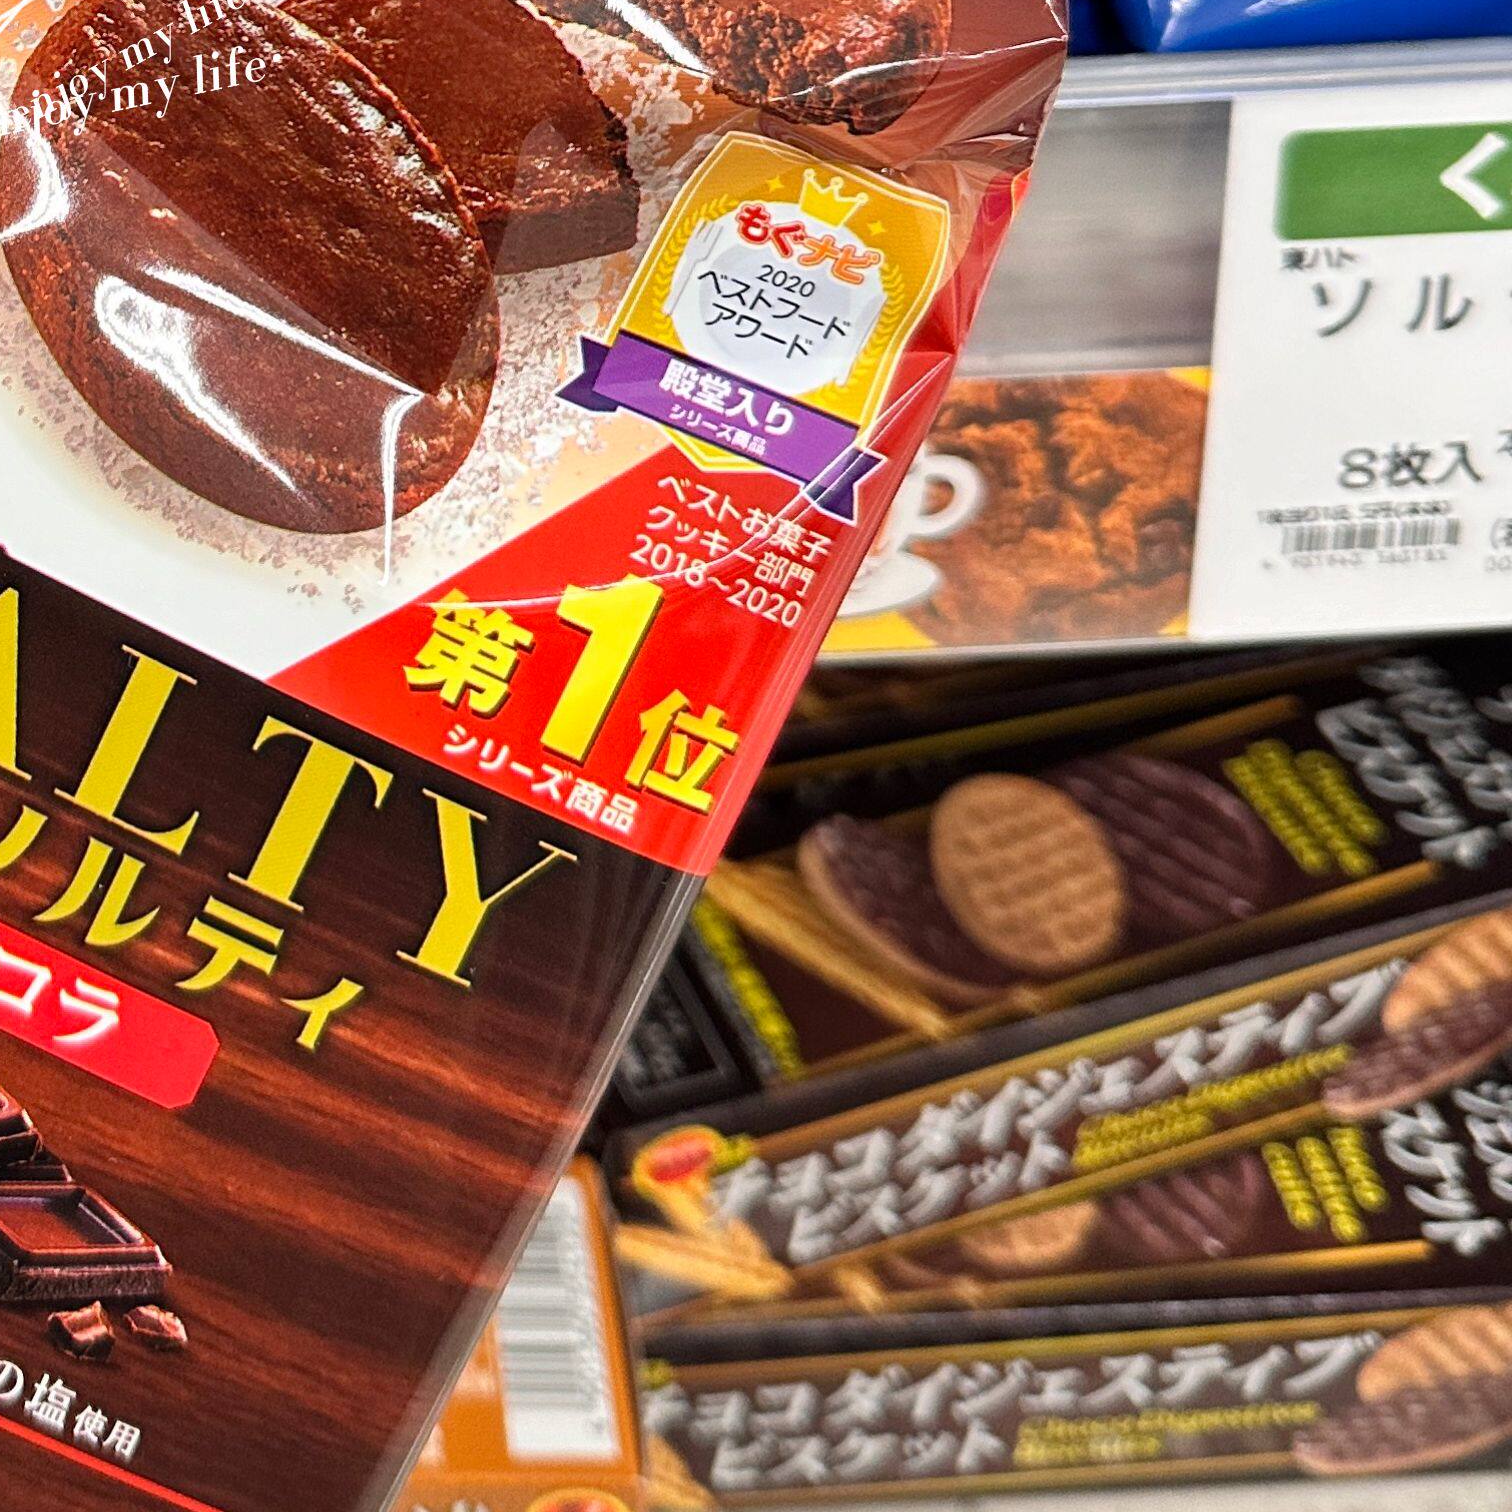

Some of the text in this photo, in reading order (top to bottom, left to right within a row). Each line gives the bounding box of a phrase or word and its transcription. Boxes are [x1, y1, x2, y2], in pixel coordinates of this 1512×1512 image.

[734, 199, 886, 287] もぐナビ
[756, 262, 817, 300] 2020
[696, 266, 856, 342] ベストフード
[701, 301, 815, 361] アワード
[658, 359, 798, 437] 殿堂入り
[667, 401, 771, 458] シリーズ商品
[1338, 440, 1485, 491] 8枚入
[645, 501, 819, 597] クッキー部門
[654, 471, 834, 561] ベストお菓子
[401, 571, 742, 816] 第1位
[440, 721, 636, 834] シリーズ商品
